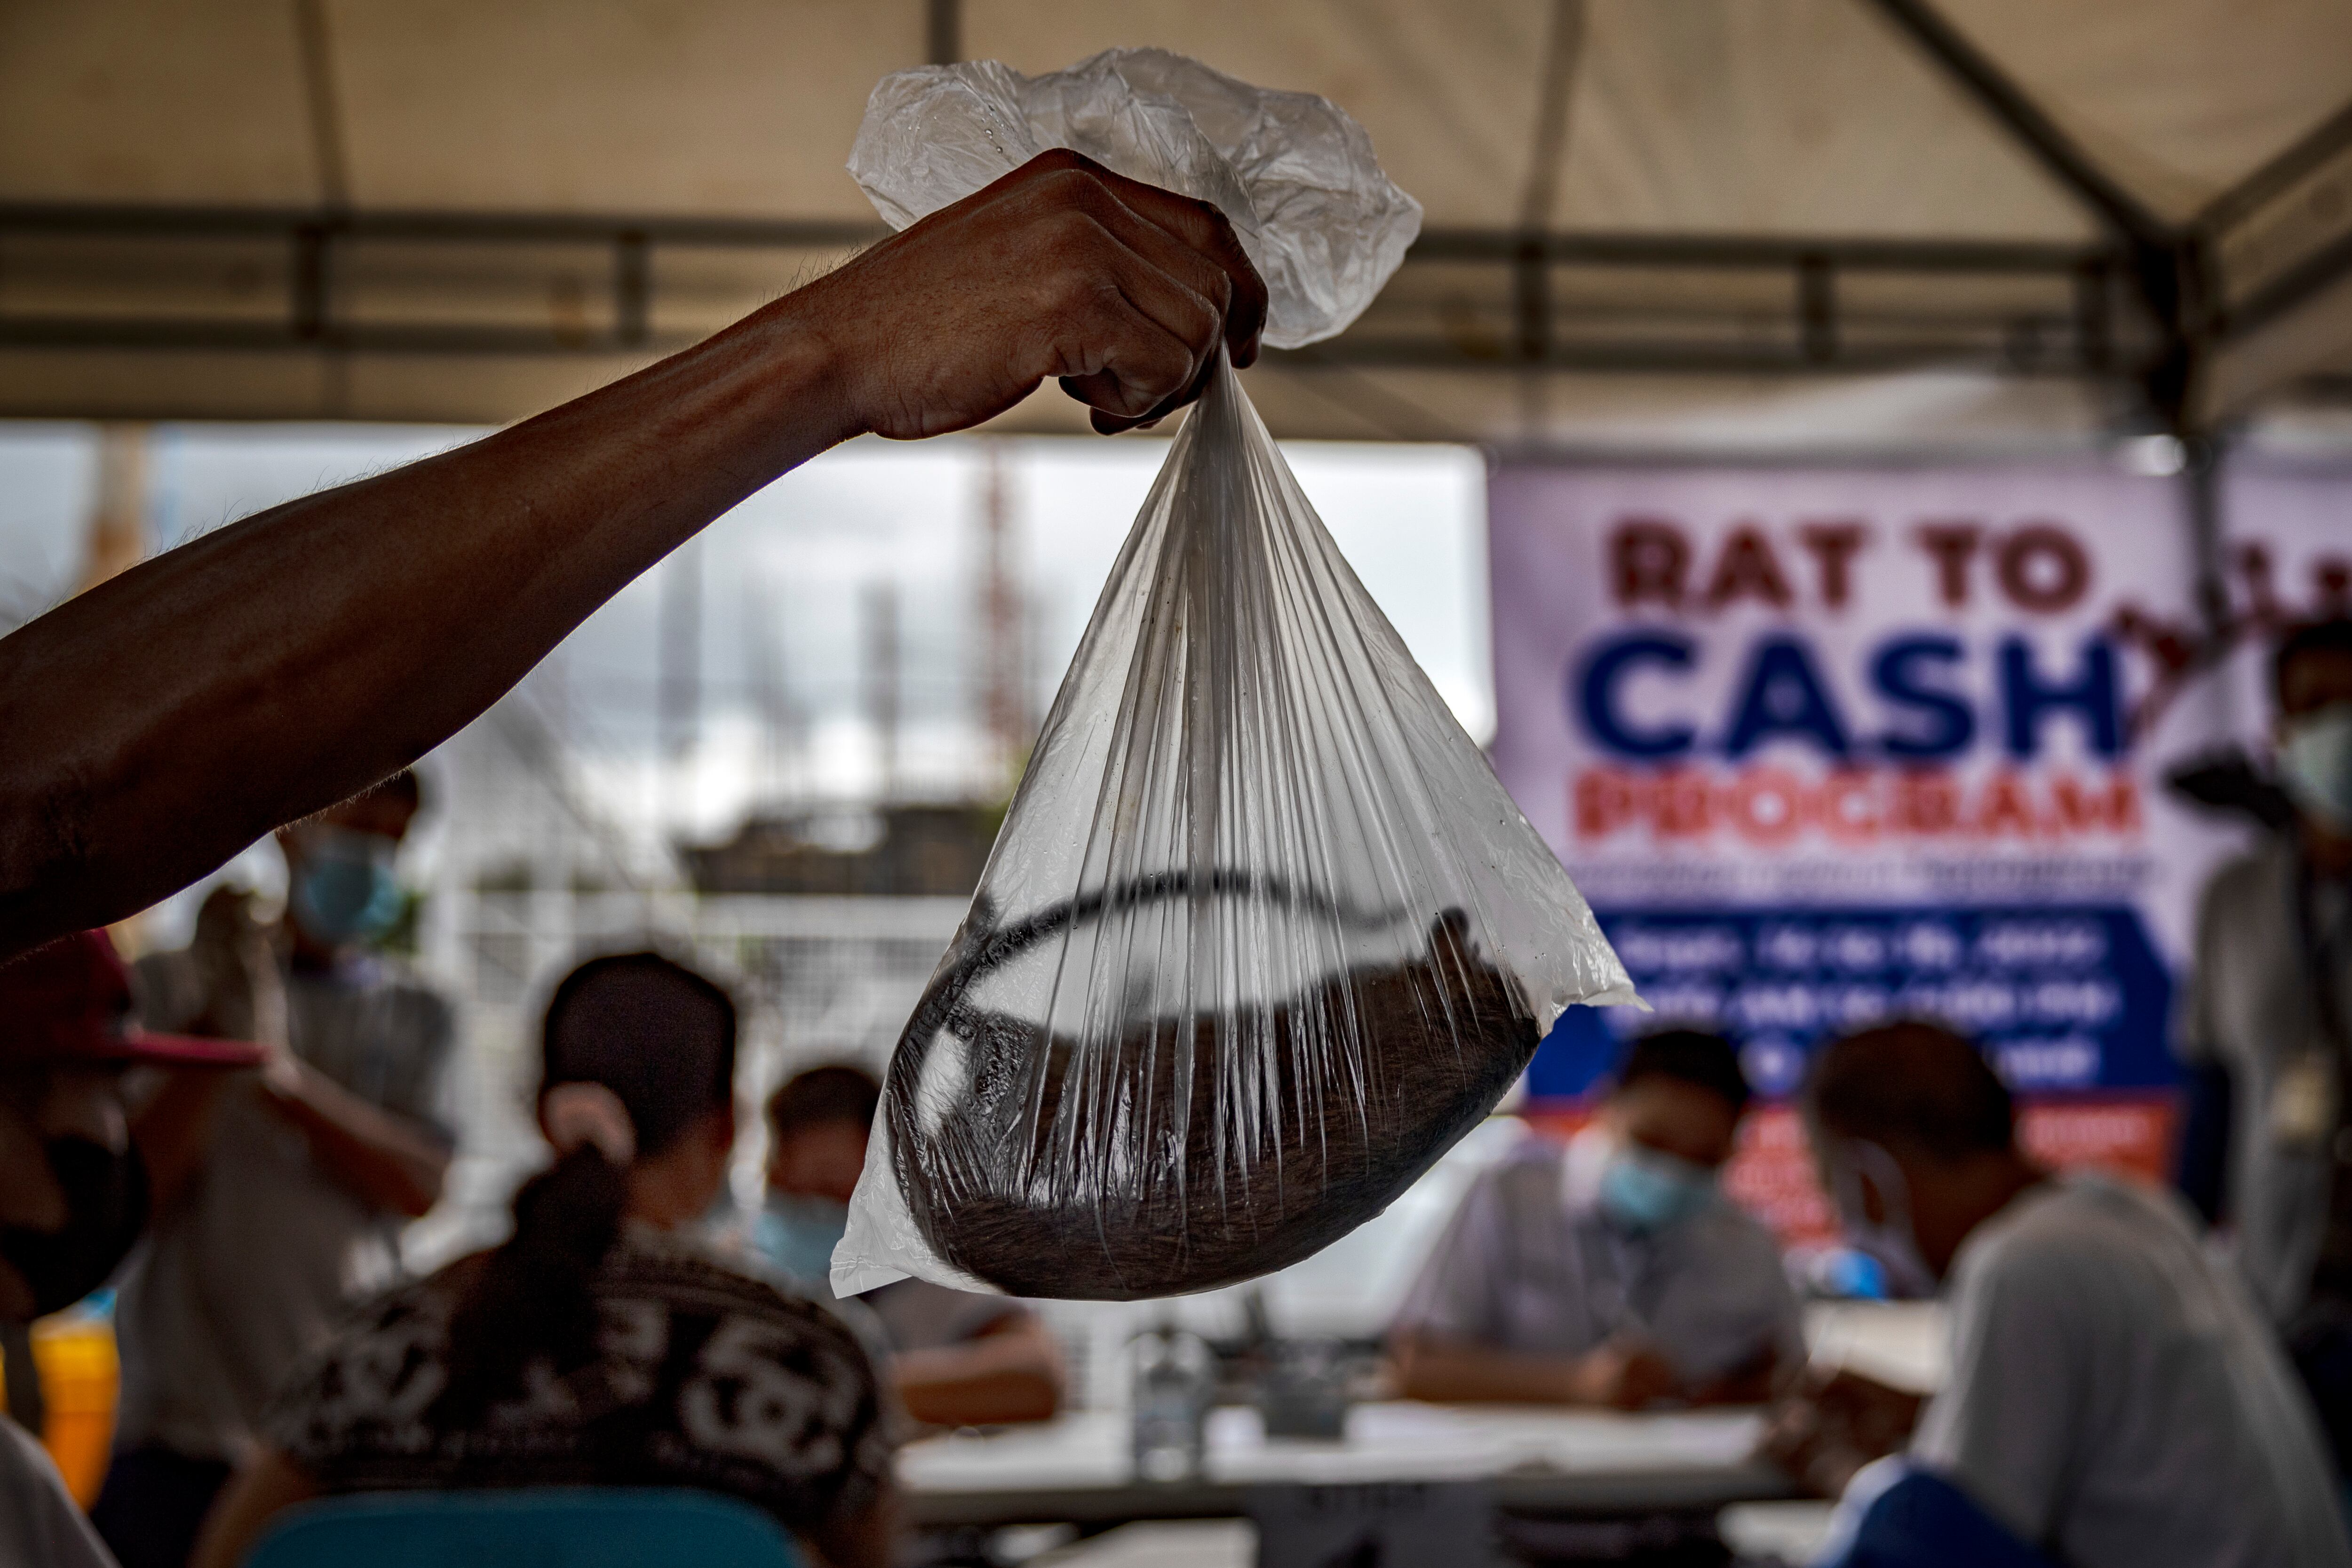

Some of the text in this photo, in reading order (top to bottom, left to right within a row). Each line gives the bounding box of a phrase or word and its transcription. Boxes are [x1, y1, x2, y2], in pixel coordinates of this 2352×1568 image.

[1603, 517, 2093, 615] RAT TO
[1572, 628, 2127, 761] CASH
[1573, 772, 2143, 846] PROGRAM
